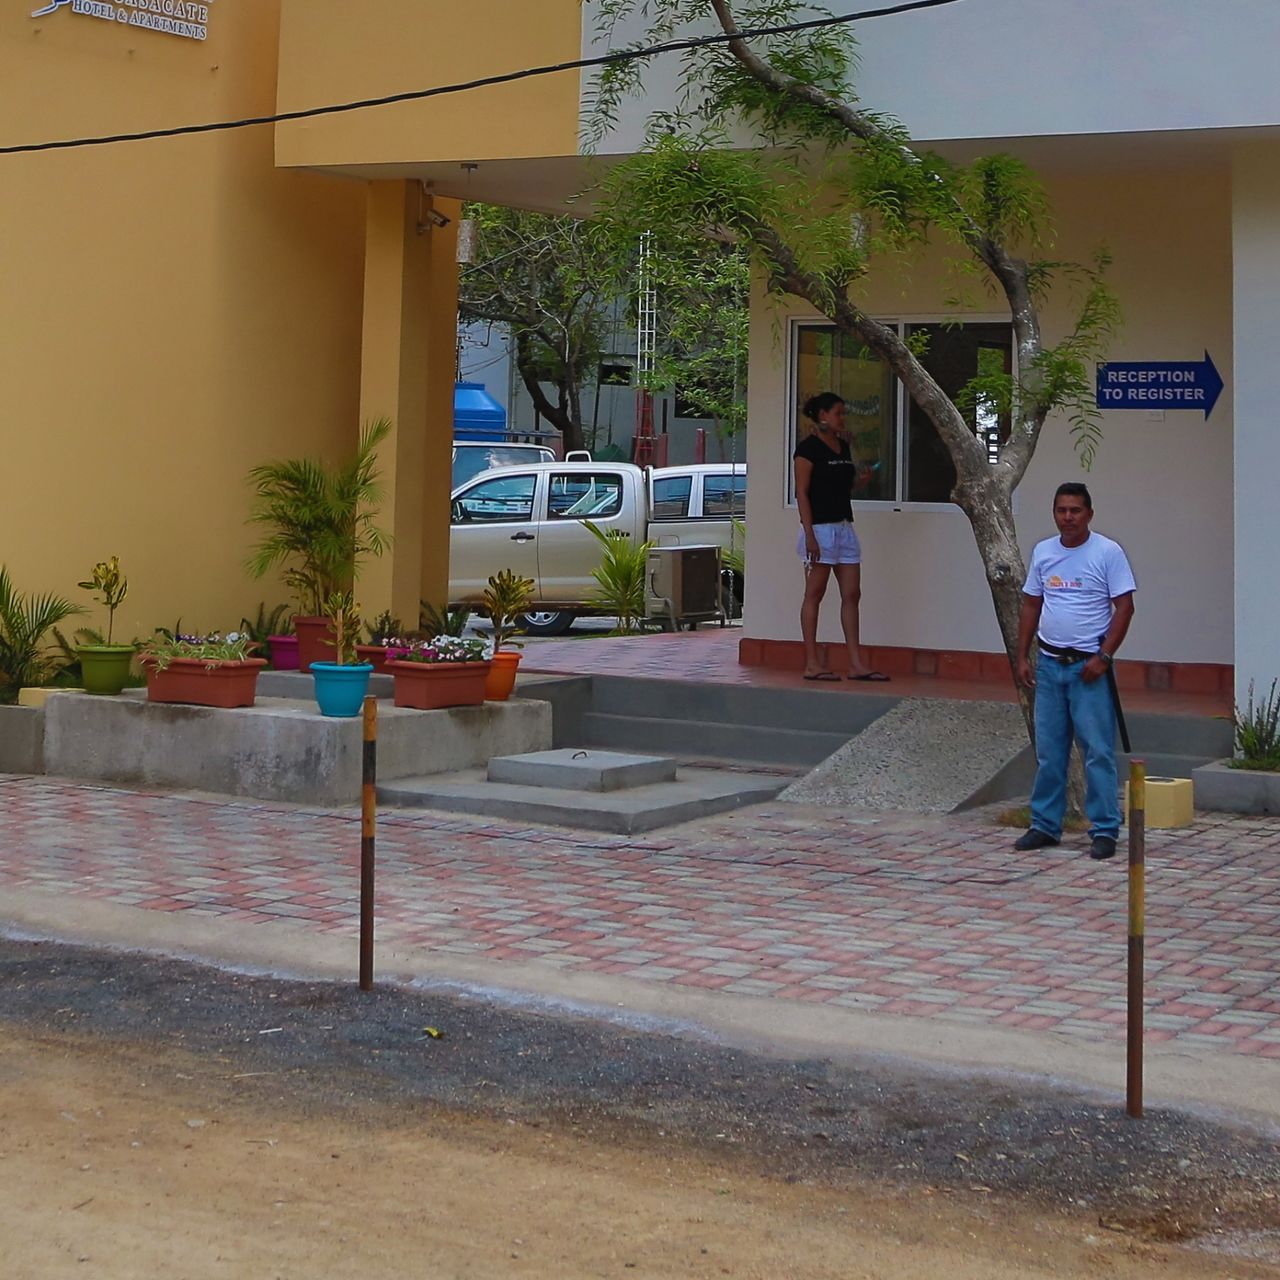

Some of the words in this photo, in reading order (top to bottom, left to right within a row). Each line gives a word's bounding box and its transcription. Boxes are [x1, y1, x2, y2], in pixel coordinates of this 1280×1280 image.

[73, 0, 114, 19] HOTEL
[117, 8, 127, 22] &
[129, 11, 207, 40] APARTMENTS
[1107, 371, 1195, 383] RECEPTION
[1102, 388, 1123, 400] TO
[1127, 388, 1205, 400] REGISTER
